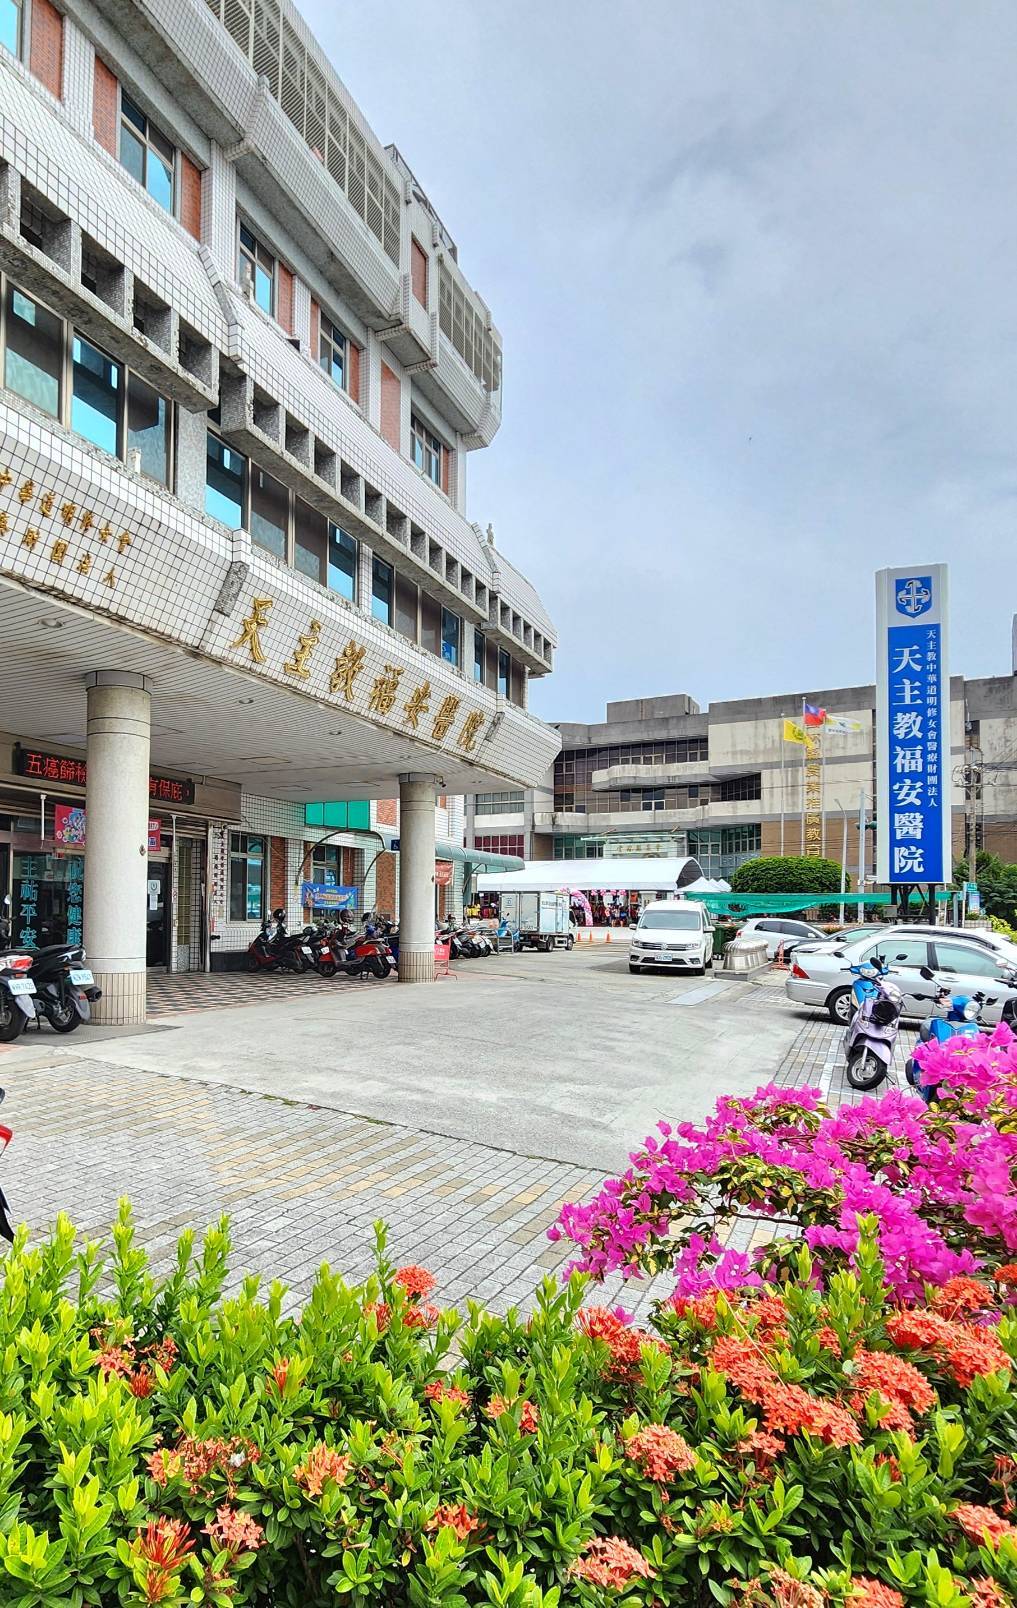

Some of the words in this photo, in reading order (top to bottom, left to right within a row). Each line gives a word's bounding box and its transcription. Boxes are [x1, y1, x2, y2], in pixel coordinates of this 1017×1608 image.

[229, 597, 485, 752] 天主教福安醫院
[892, 645, 924, 873] 天主教福安醫院
[926, 629, 938, 808] 天主教中華道明修女會醫療財團法人
